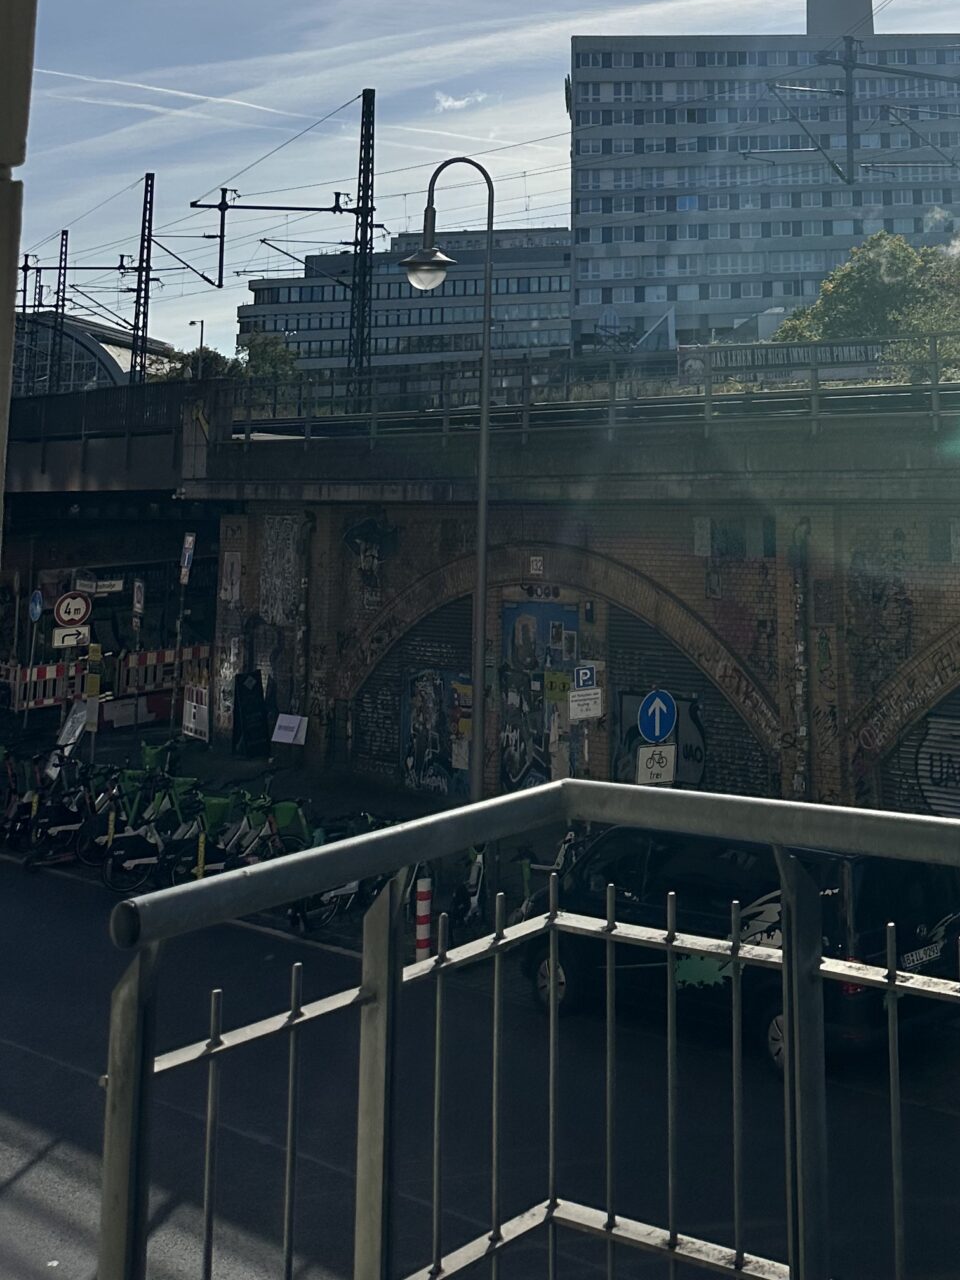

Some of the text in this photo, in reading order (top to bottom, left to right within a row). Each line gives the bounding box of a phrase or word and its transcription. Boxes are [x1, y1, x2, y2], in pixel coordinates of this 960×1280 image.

[64, 602, 81, 616] 4 m
[649, 770, 662, 780] frei
